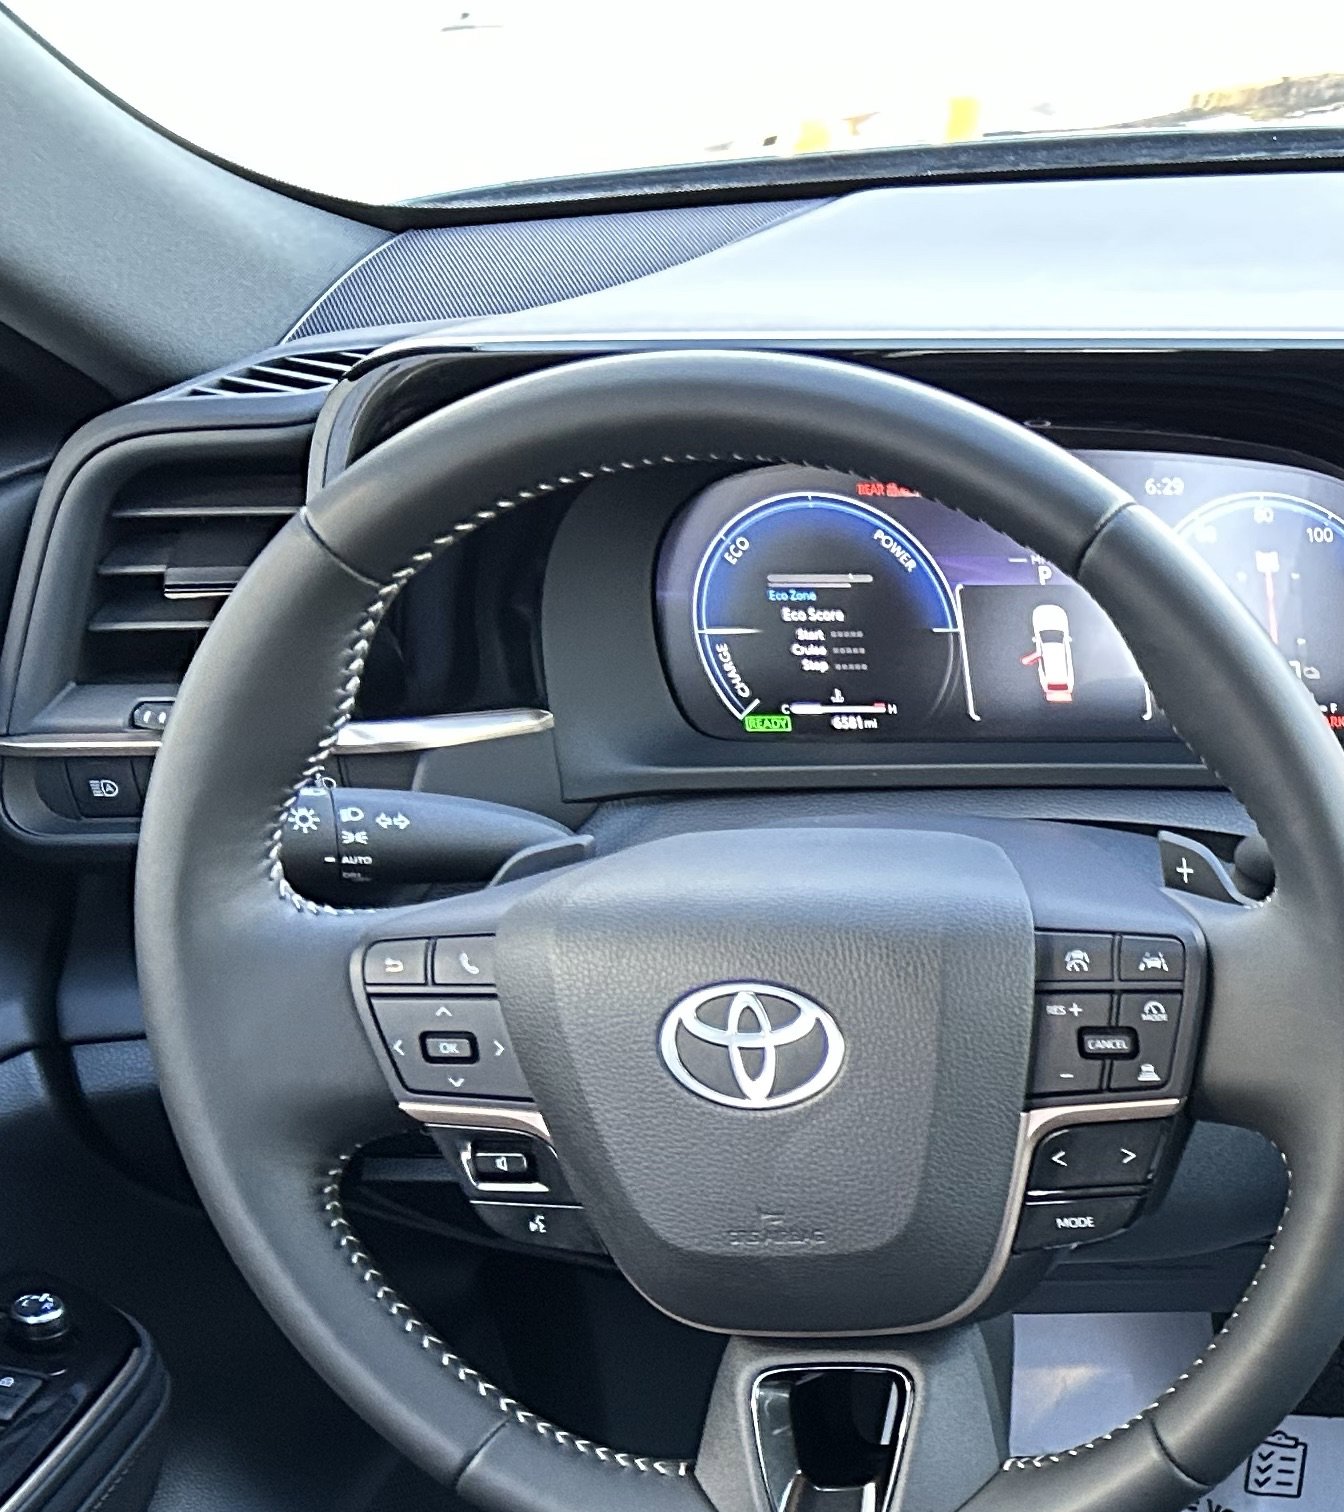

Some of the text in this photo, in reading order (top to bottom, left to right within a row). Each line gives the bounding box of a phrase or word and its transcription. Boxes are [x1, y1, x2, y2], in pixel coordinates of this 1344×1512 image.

[1145, 476, 1184, 496] 6:29
[1306, 527, 1333, 543] 100
[724, 536, 750, 566] ECO
[873, 529, 918, 573] POWER
[1038, 565, 1052, 586] P
[768, 589, 817, 601] Eco Zone
[781, 605, 845, 622] Eco Score
[715, 643, 751, 699] CHARGE
[781, 704, 791, 715] C
[887, 704, 898, 715] H
[747, 716, 788, 731] READY
[341, 856, 373, 865] AUTO
[438, 1042, 461, 1054] OK
[1087, 1039, 1129, 1051] CANCEL
[1056, 1215, 1095, 1229] MODE
